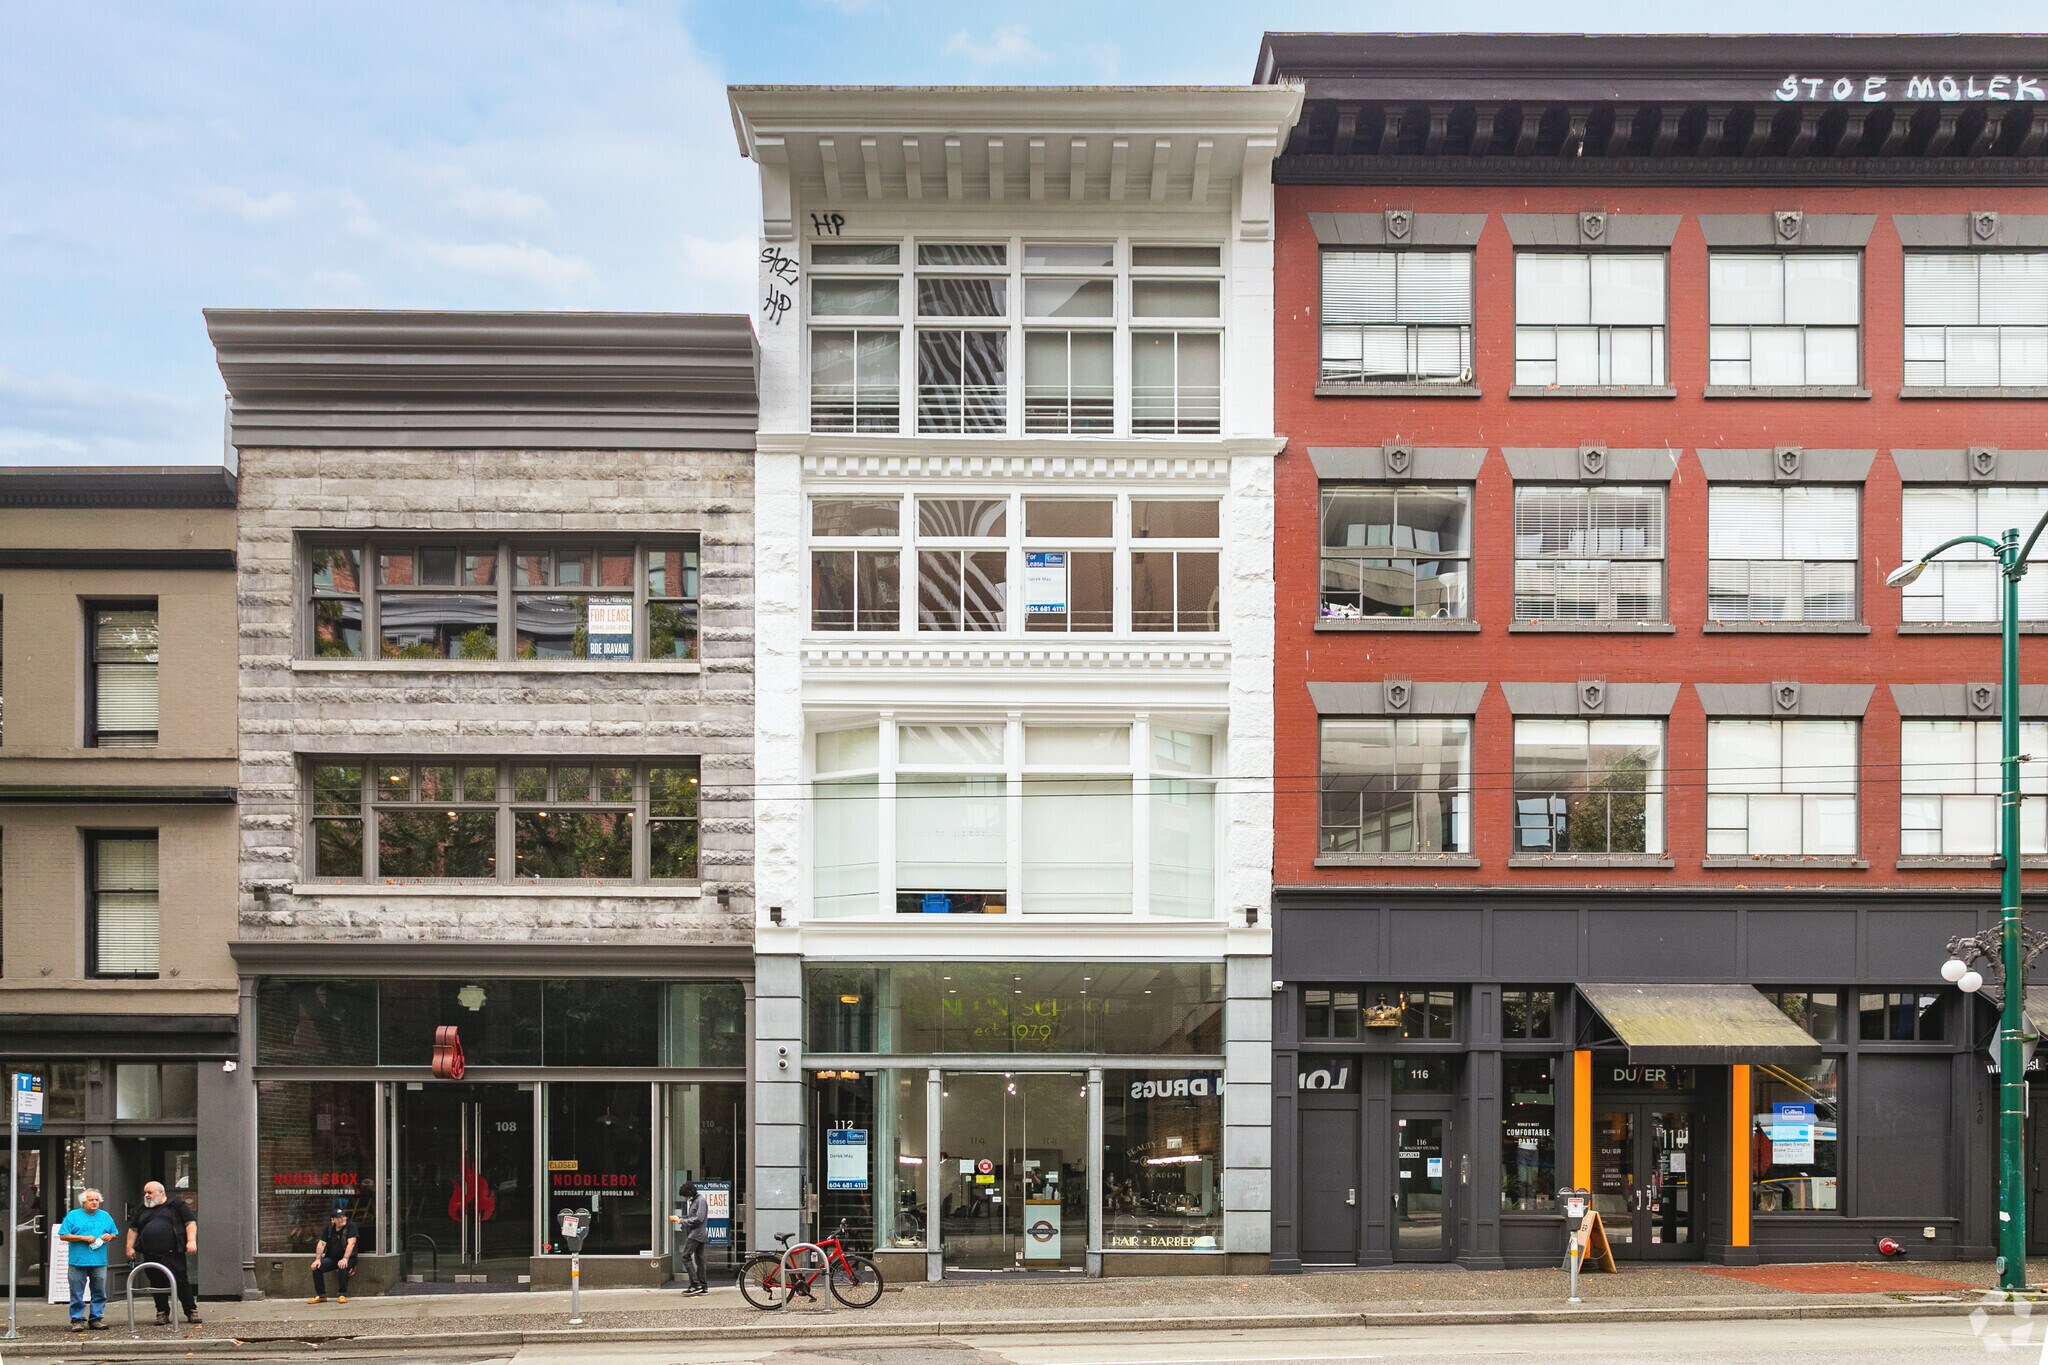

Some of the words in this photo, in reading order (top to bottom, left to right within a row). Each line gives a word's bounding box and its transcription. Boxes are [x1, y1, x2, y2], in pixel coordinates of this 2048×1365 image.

[1774, 74, 1888, 103] STOE
[1905, 75, 2046, 102] MOLEK
[810, 212, 845, 236] HP
[763, 284, 792, 325] HP
[590, 608, 605, 622] FOR
[607, 608, 630, 622] LEASE
[975, 1023, 1006, 1037] est.
[1411, 1070, 1428, 1079] 116
[495, 1122, 517, 1132] 108
[702, 1120, 714, 1128] 110
[834, 1120, 854, 1129] 112
[549, 1161, 577, 1169] CLOSED
[274, 1173, 357, 1185] NOODLEBOX
[553, 1174, 637, 1186] NOODLEBOX
[1112, 1236, 1139, 1246] HAIR
